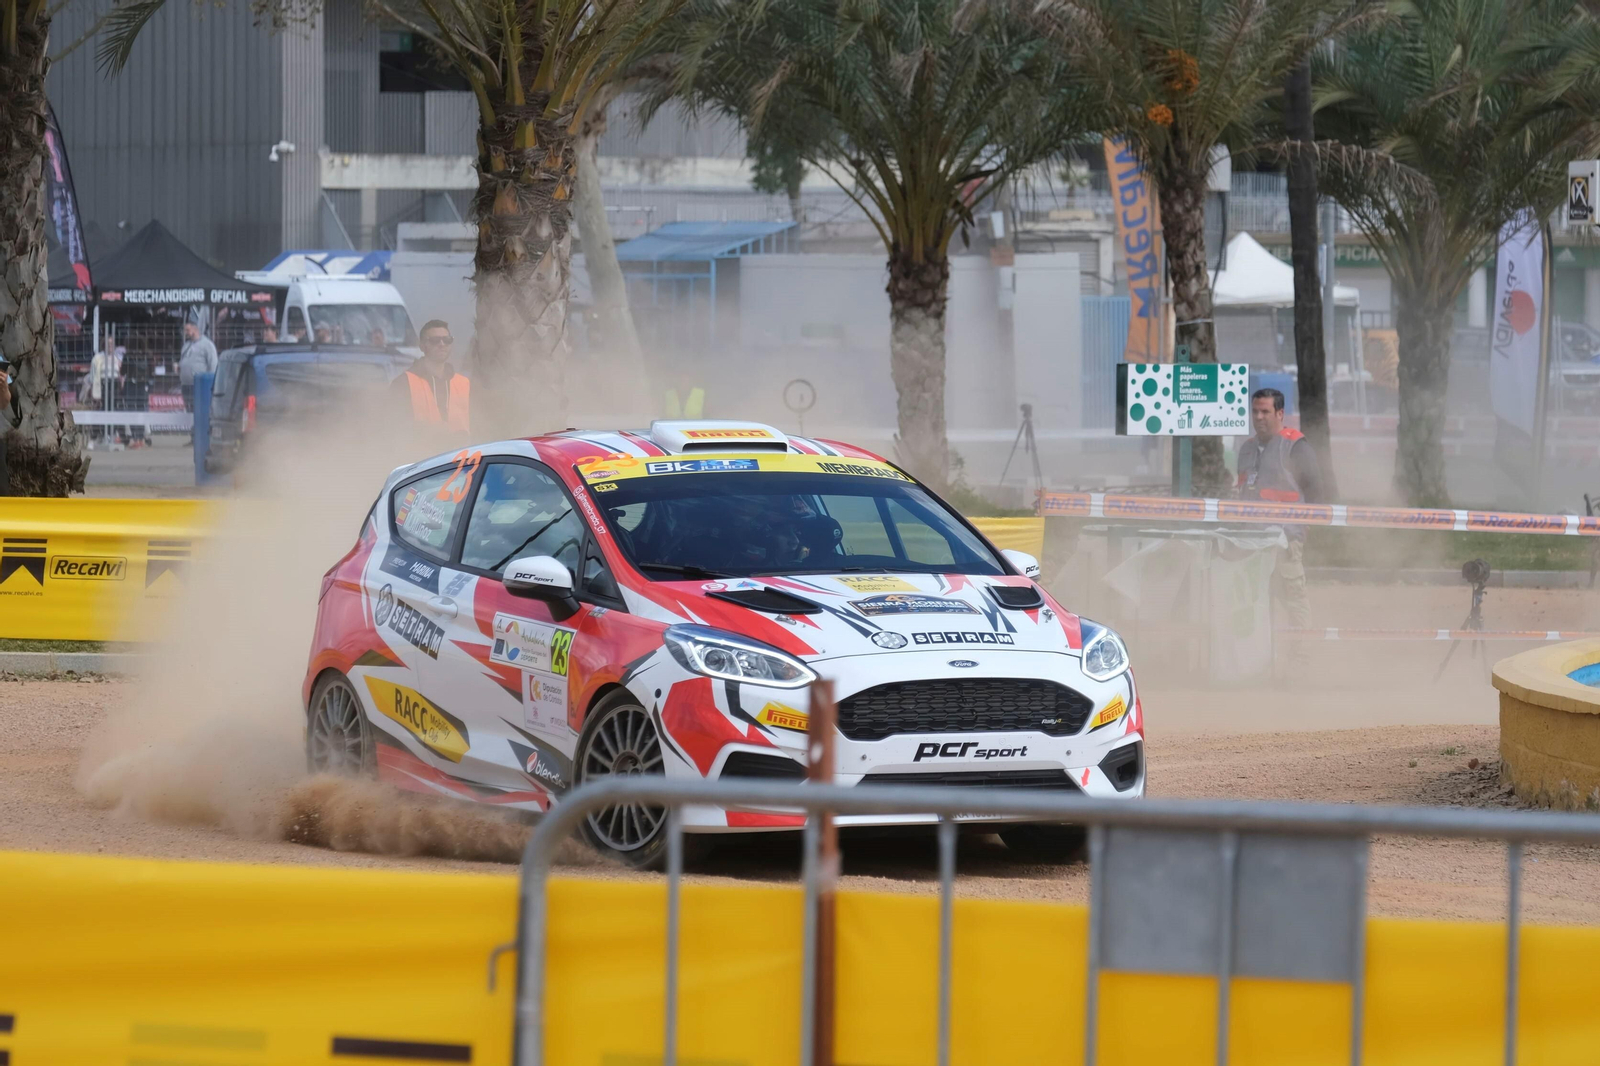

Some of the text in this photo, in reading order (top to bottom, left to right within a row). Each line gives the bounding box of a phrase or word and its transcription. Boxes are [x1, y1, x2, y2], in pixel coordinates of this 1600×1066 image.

[124, 288, 205, 304] MERCHANDISING
[210, 289, 249, 304] OFICIAL
[1179, 373, 1208, 381] papeleras
[1213, 417, 1246, 428] sadeco
[686, 429, 772, 439] PIRELLI
[576, 452, 640, 472] 23
[817, 461, 910, 481] MEMBRADO
[435, 448, 483, 504] 23
[1486, 515, 1548, 529] Recalvi
[53, 559, 123, 577] Recalvi
[409, 561, 435, 579] MARINA
[514, 572, 536, 580] pcr
[857, 601, 905, 609] SIERRA
[905, 599, 963, 608] MORENA
[391, 605, 442, 655] SETRAM
[914, 632, 1014, 645] SETRAM
[550, 630, 572, 676] 23
[954, 660, 973, 668] Ford
[394, 687, 428, 737] RACC
[1099, 701, 1124, 723] PIRELLI
[428, 726, 439, 743] Club
[429, 714, 451, 740] Mobility
[913, 741, 1029, 763] pcr sport
